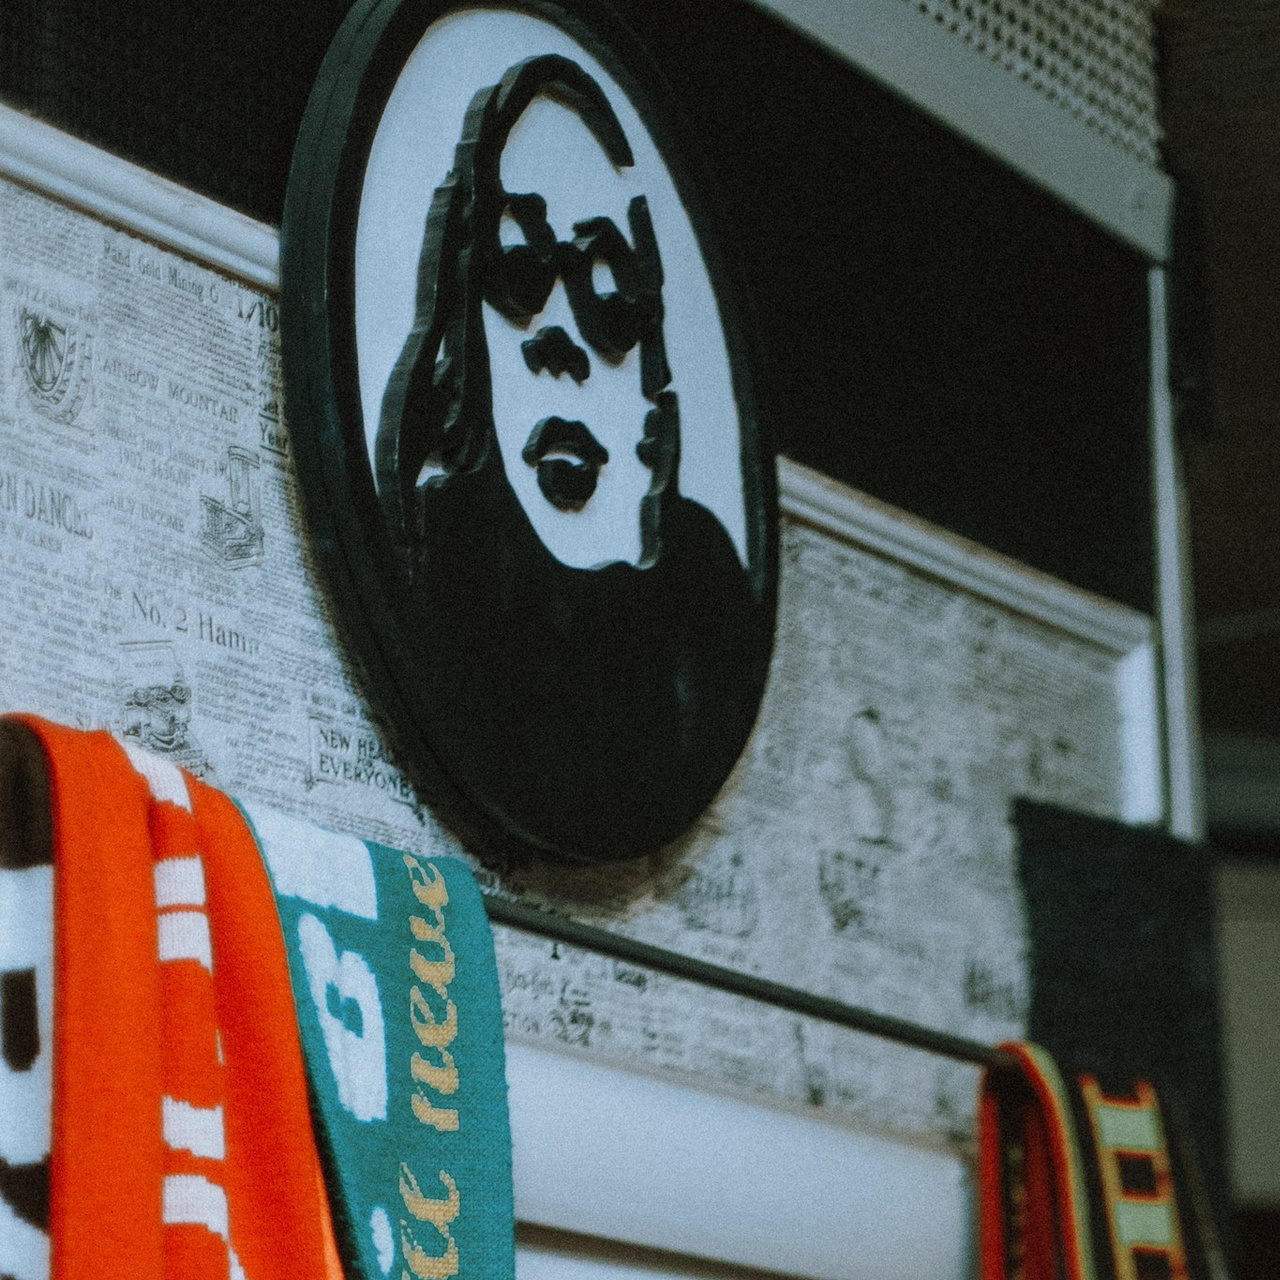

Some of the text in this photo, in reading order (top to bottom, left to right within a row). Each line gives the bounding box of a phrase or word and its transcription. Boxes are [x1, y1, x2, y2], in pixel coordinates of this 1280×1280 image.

[131, 590, 167, 629] No.
[175, 606, 189, 632] 2
[319, 728, 350, 751] NEW
[319, 753, 412, 798] EVERYONE
